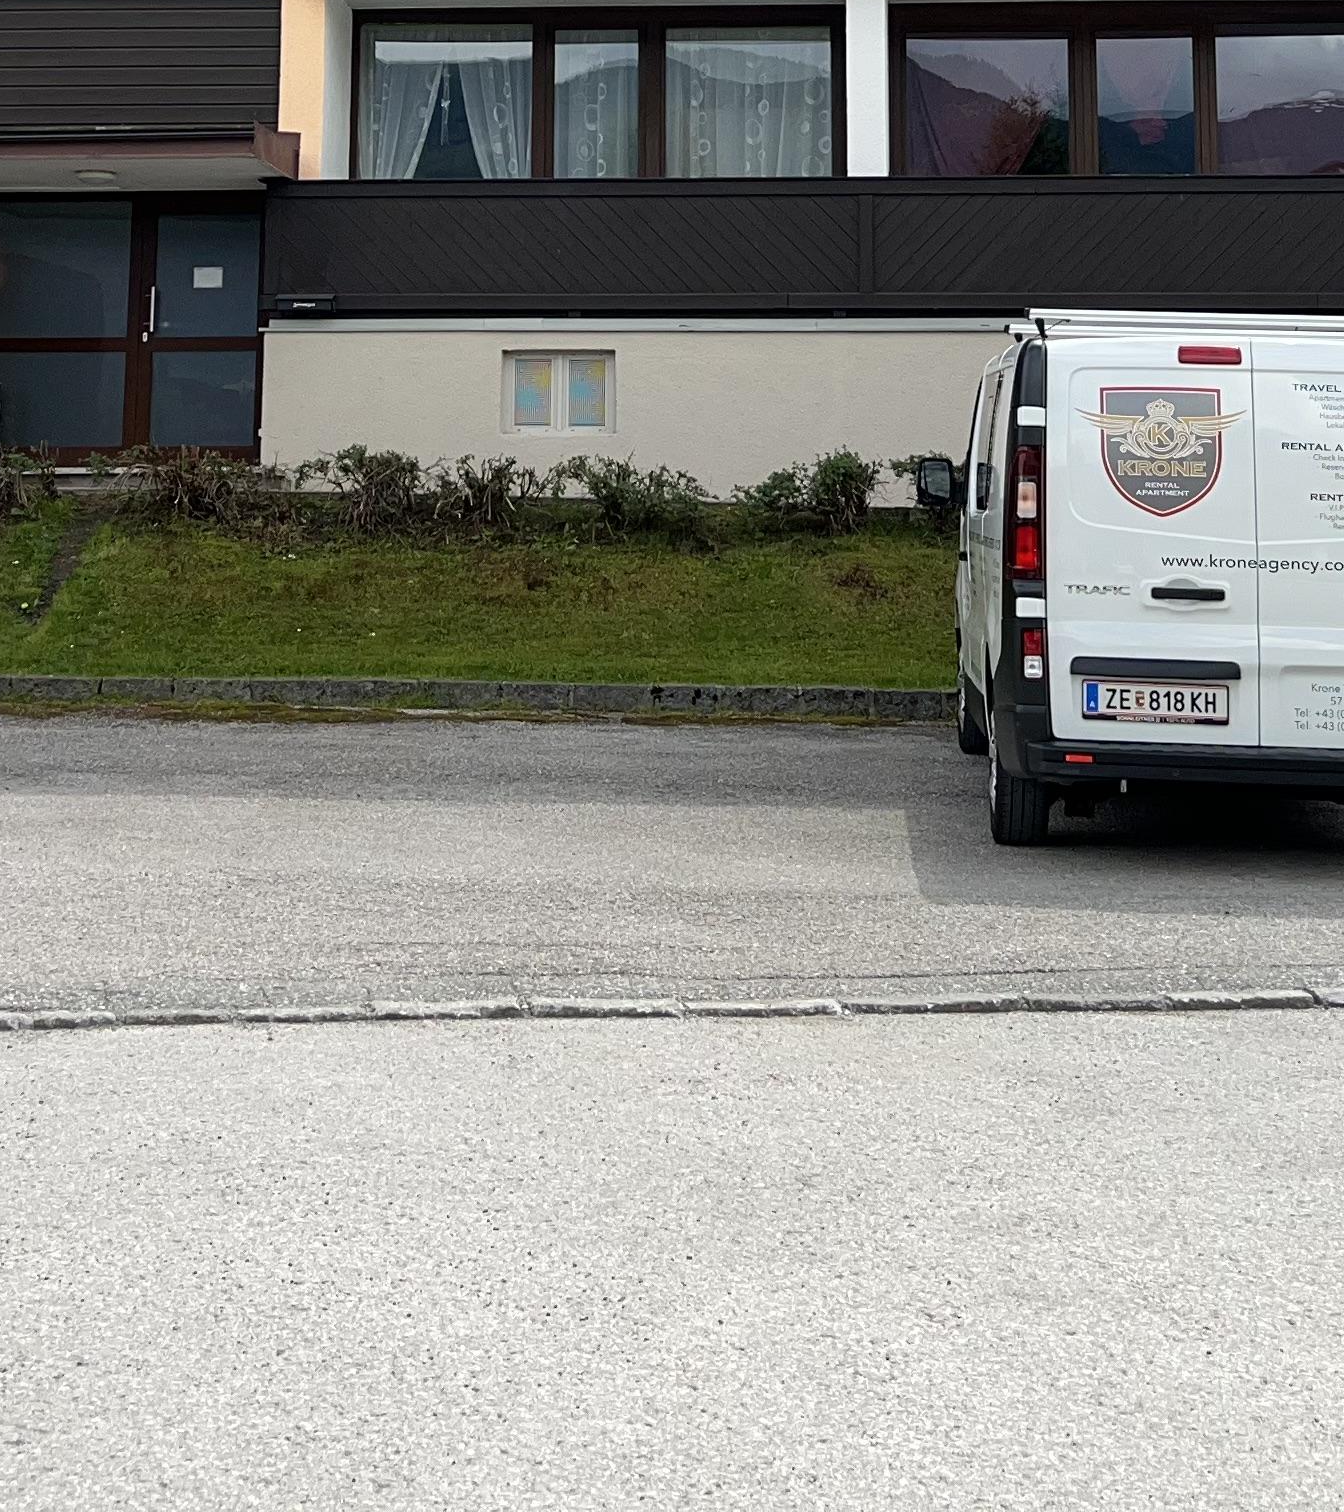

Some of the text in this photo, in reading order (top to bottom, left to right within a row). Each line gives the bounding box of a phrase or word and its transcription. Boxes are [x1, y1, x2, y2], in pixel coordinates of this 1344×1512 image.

[1293, 383, 1341, 392] TRAVEL
[1150, 424, 1170, 445] K
[1281, 442, 1331, 451] RENTAL
[1117, 460, 1207, 478] KRONE
[1136, 489, 1190, 497] APARTMENT
[1310, 493, 1344, 502] RENT
[1064, 584, 1131, 596] TRAFIC
[1311, 683, 1341, 692] Krone
[1089, 700, 1096, 708] A
[1105, 688, 1217, 713] ZE 818 KH
[1314, 709, 1334, 718] +43
[1314, 721, 1334, 731] +43
